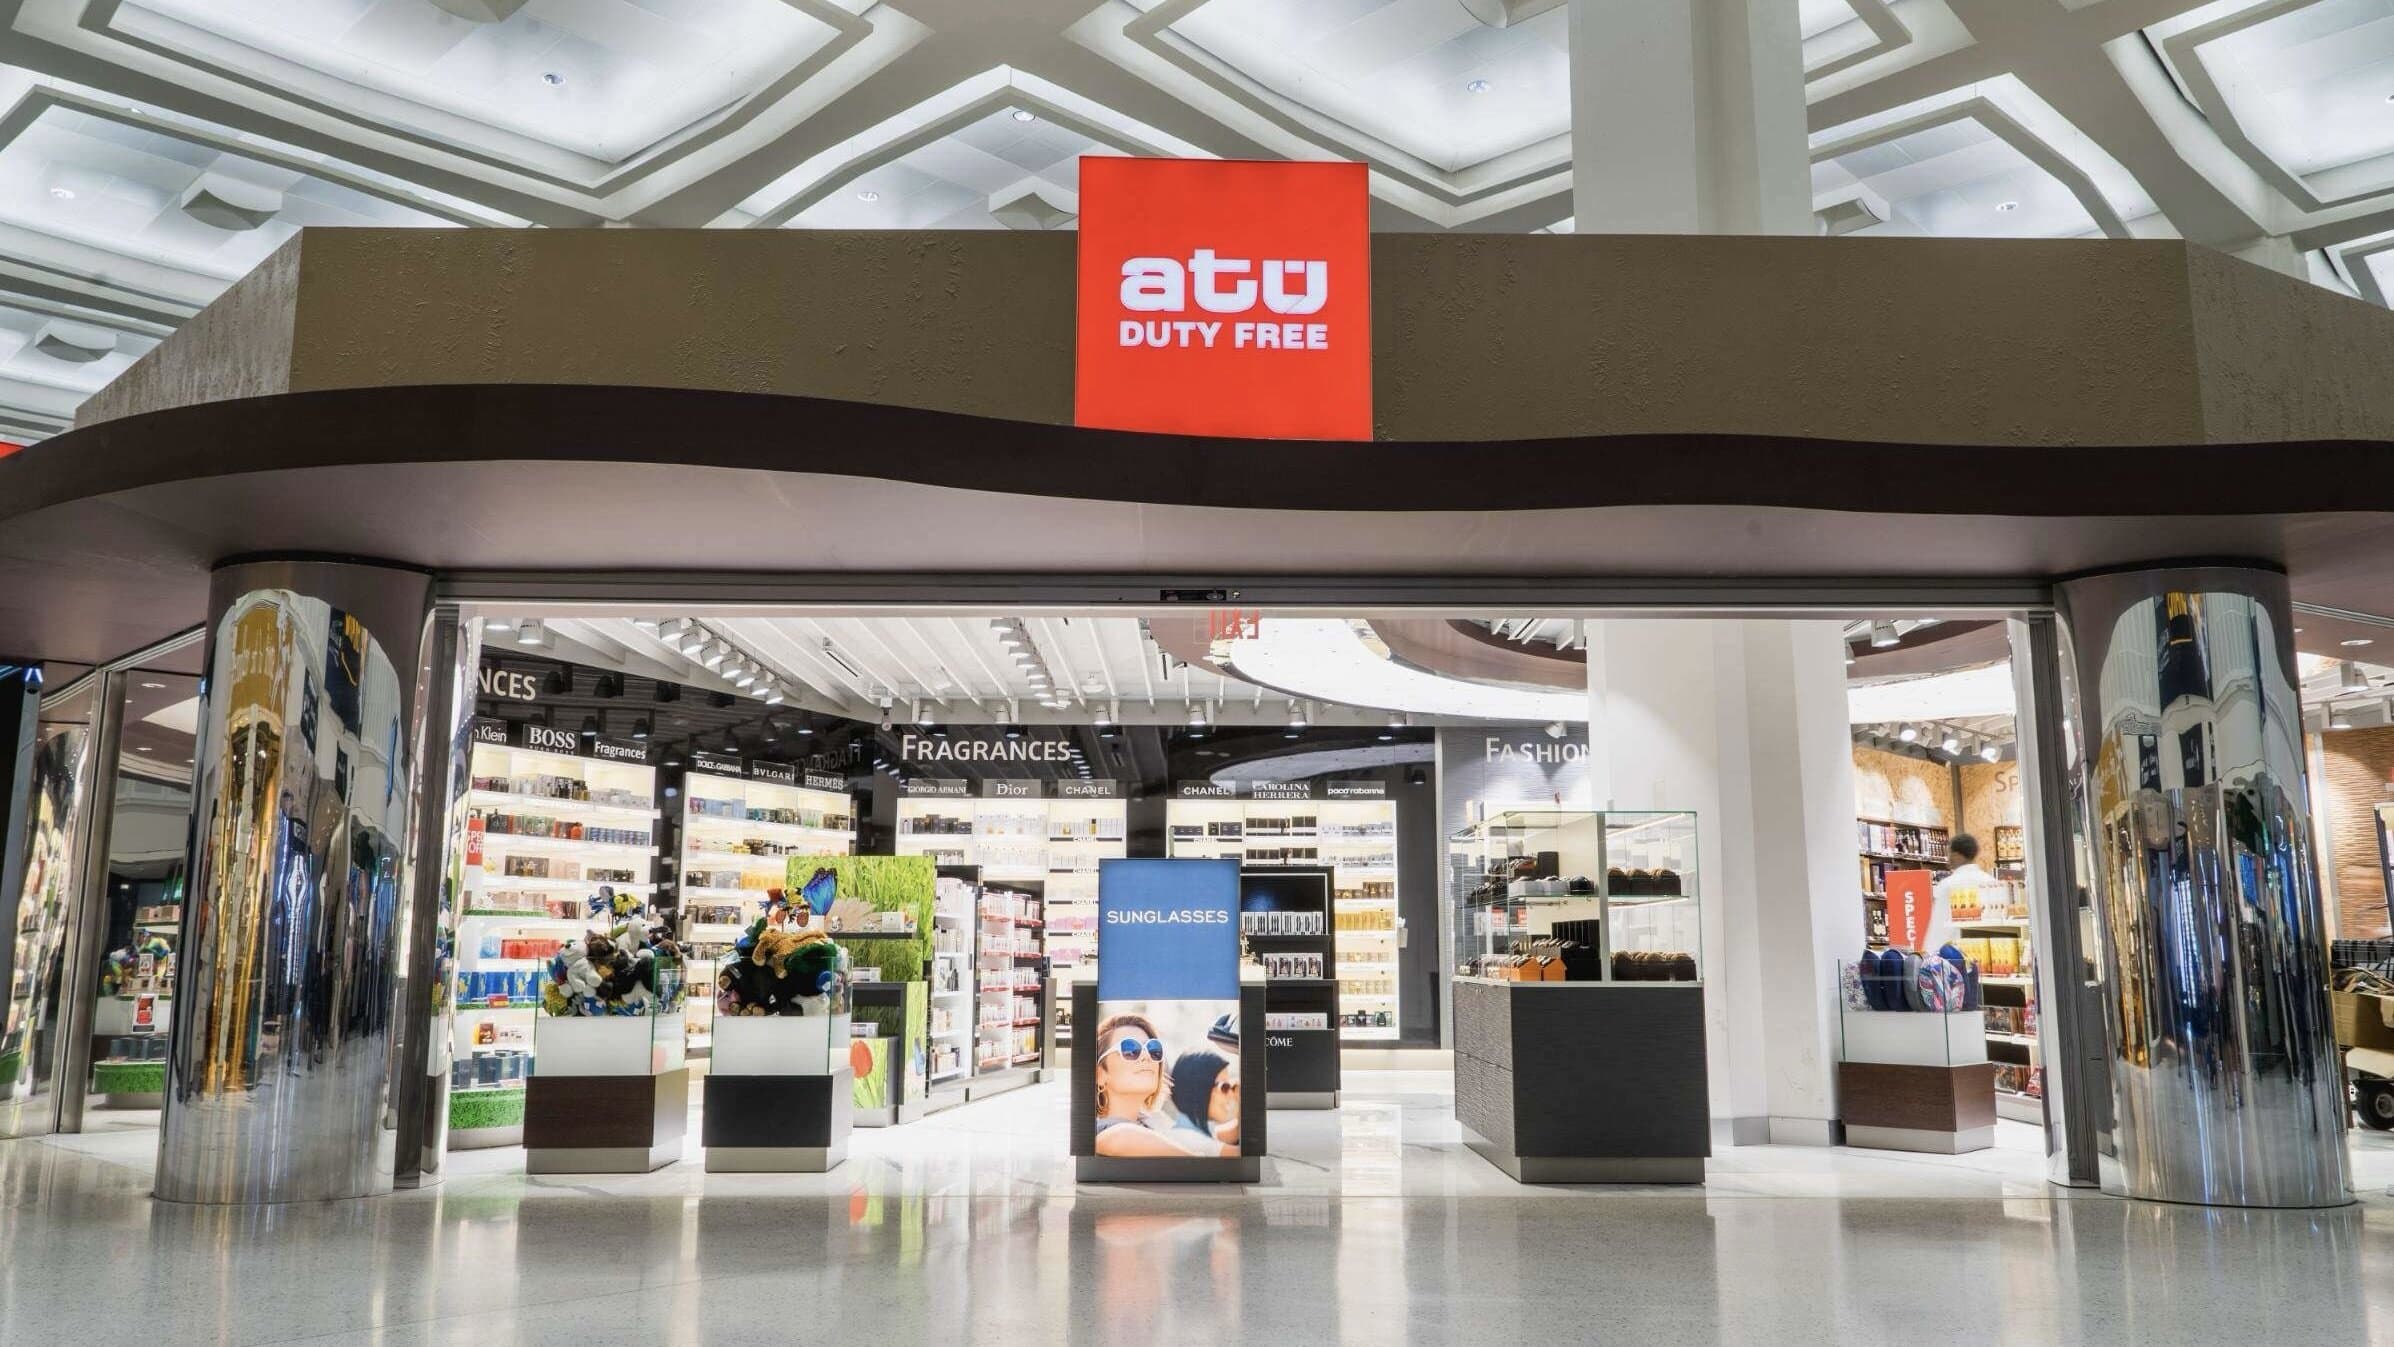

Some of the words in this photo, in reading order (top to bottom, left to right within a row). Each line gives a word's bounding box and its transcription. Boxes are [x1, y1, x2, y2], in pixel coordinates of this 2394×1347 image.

[1120, 320, 1223, 347] DUTY
[1235, 322, 1328, 349] FREE
[481, 726, 507, 743] Klein
[529, 727, 576, 750] BOSS
[594, 741, 647, 760] Fragrances
[901, 734, 1072, 761] FRAGRANCES
[996, 782, 1028, 795] Dior
[1065, 785, 1111, 795] CHANEL
[1183, 786, 1229, 796] CHANEL
[1254, 791, 1309, 799] HERRERA
[1106, 910, 1229, 925] SUNGLASSES
